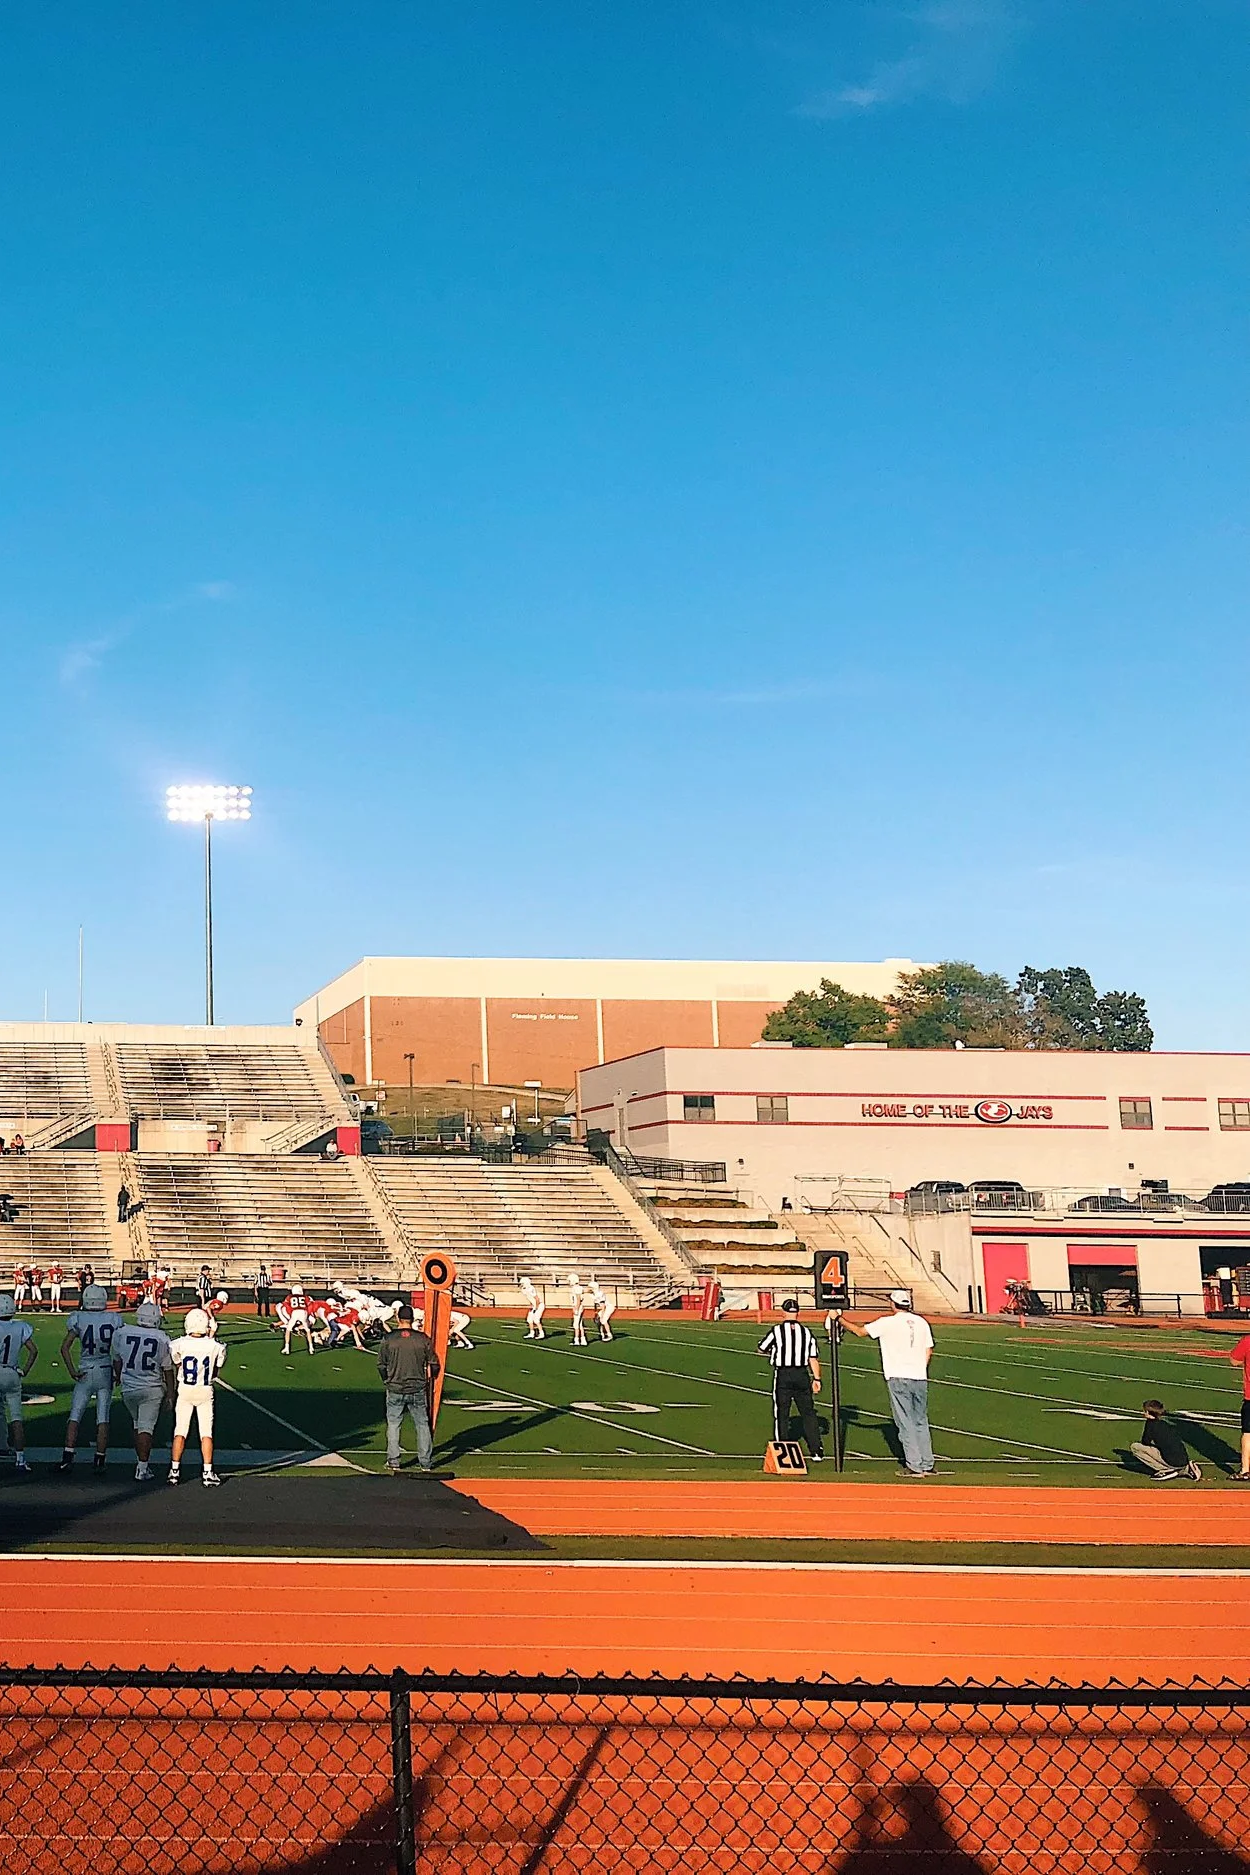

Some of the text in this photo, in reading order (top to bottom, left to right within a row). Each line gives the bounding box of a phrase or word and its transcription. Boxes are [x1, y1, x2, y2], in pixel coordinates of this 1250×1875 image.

[861, 1103, 1054, 1119] HOME OF THE JAYS
[821, 1256, 845, 1288] 4
[290, 1296, 306, 1308] 85
[3, 1335, 11, 1364] 1
[81, 1324, 114, 1355] 49
[126, 1336, 158, 1371] 72
[182, 1356, 210, 1386] 81
[773, 1442, 805, 1469] 20
